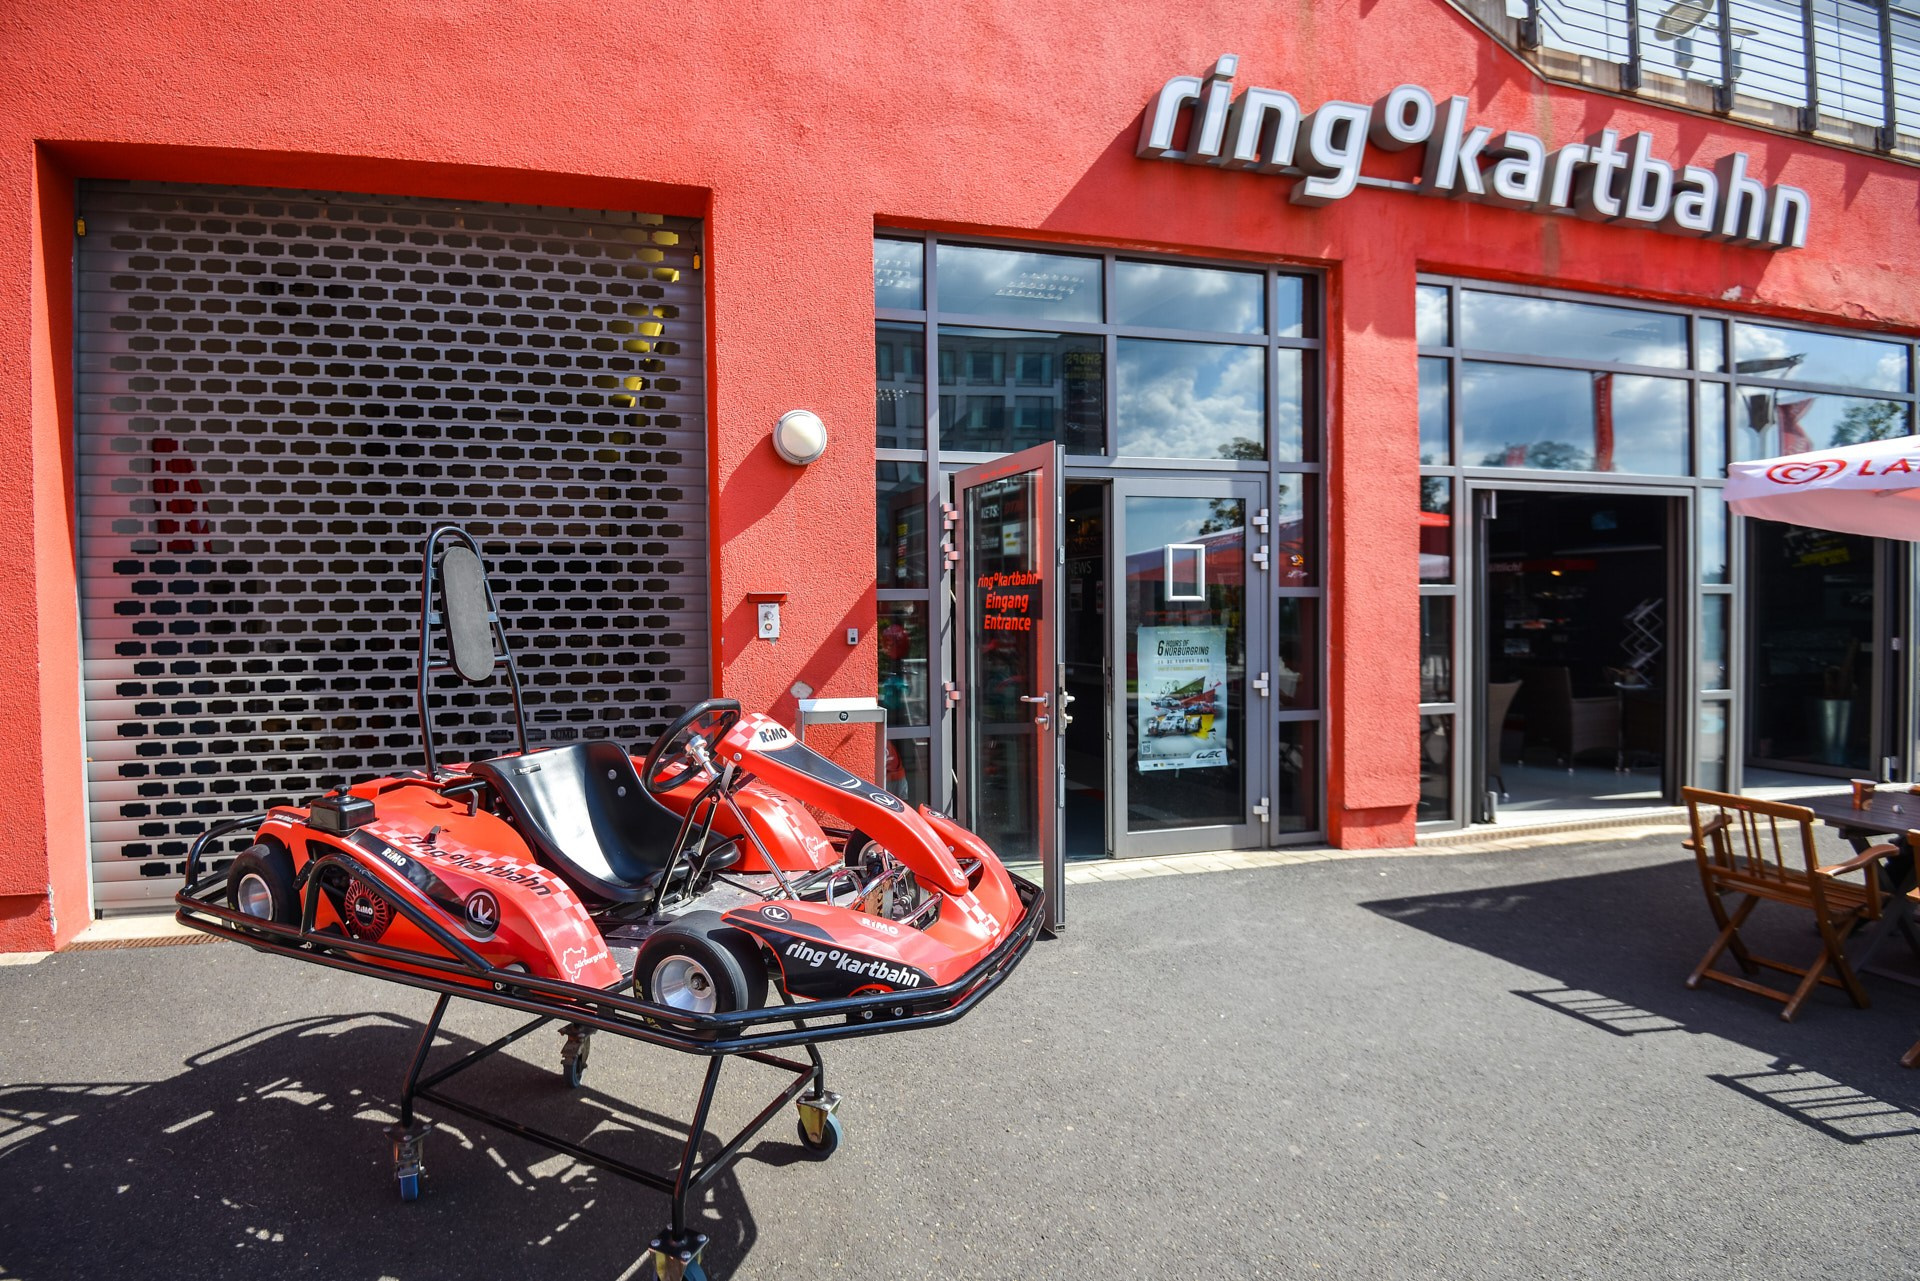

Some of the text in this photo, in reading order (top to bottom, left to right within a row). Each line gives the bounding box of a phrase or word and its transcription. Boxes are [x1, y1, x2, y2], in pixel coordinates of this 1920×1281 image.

[1857, 457, 1920, 476] LA
[985, 592, 1029, 613] Eingang
[984, 614, 1031, 631] Entrance
[1157, 639, 1190, 656] 6 HOURS OF
